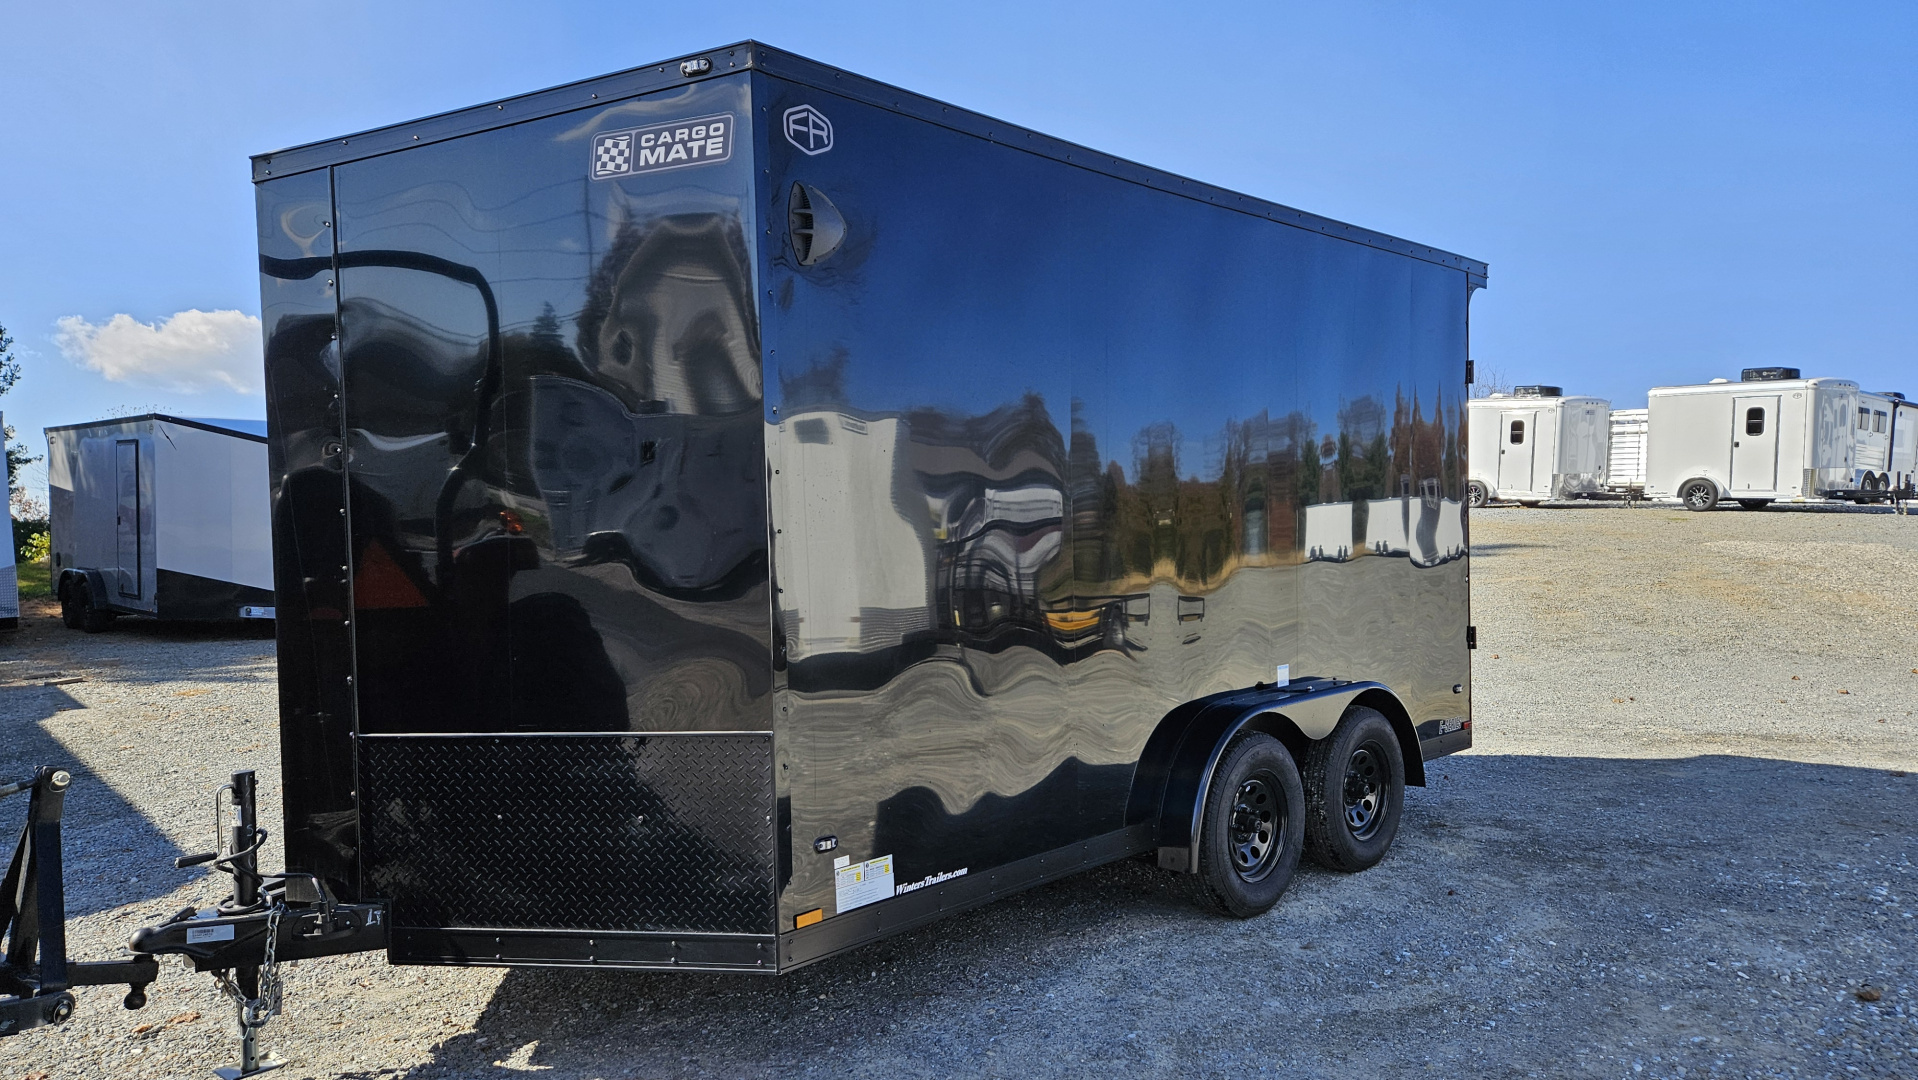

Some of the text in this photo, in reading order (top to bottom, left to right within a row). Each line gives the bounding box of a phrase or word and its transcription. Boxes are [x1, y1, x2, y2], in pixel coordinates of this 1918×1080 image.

[640, 122, 725, 147] CARGO
[639, 136, 724, 166] MATE
[895, 867, 968, 896] WintersTrailers.com
